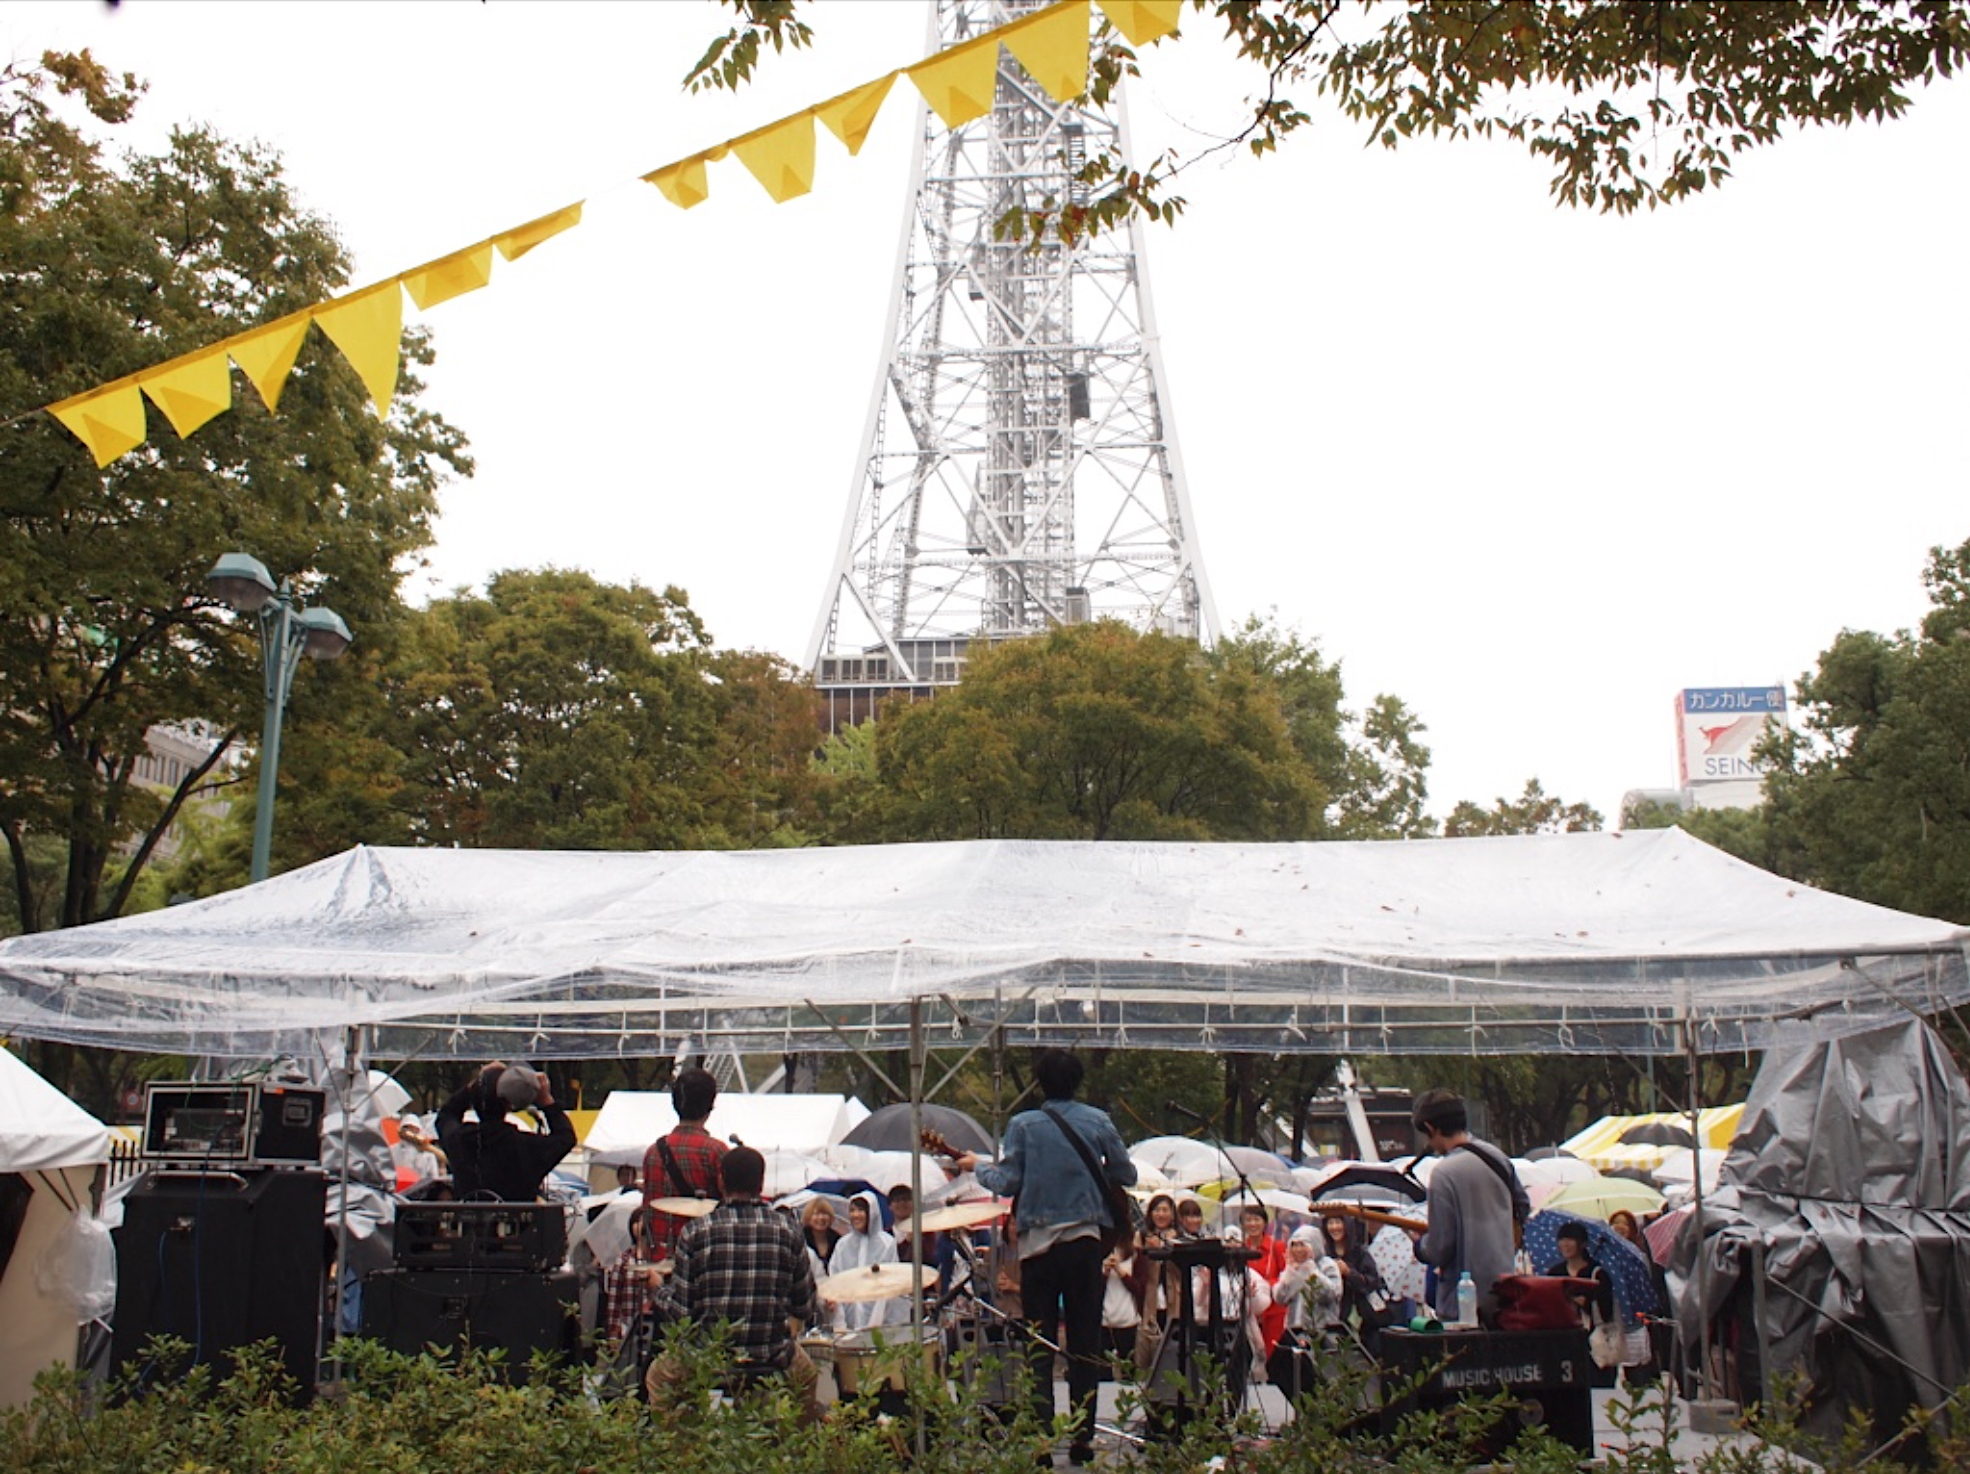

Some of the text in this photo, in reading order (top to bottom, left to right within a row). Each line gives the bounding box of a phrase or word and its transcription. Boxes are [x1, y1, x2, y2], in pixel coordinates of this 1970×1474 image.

[1690, 690, 1782, 709] カンガルー便
[1442, 1360, 1573, 1388] MUSIC HOUSE 3
